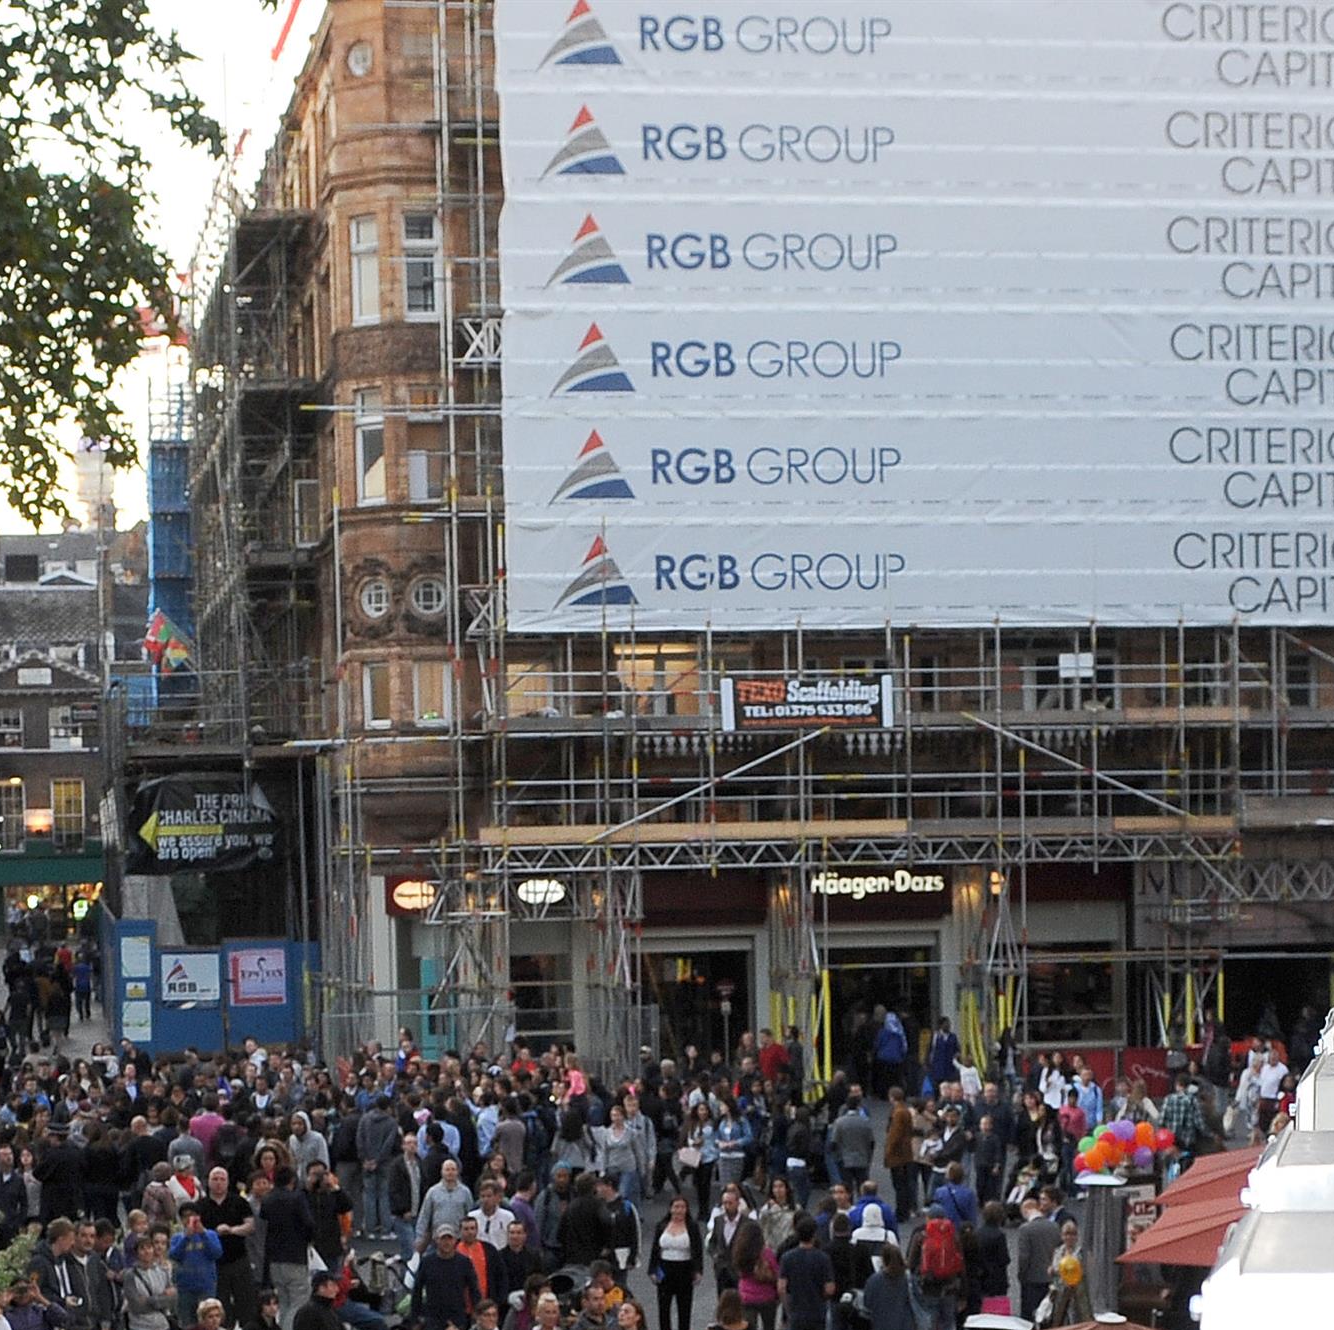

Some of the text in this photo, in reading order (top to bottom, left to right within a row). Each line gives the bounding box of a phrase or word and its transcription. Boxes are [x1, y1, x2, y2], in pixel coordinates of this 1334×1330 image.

[638, 14, 892, 55] RGB GROUP
[641, 122, 895, 164] RGB GROUP
[646, 231, 898, 271] RGB GROUP
[650, 340, 902, 378] RGB GROUP
[650, 447, 902, 485] RGB GROUP
[654, 553, 906, 591] RGB GROUP
[787, 680, 880, 705] Scaffolding
[743, 705, 774, 717] TEL:
[194, 793, 219, 809] THE
[158, 809, 216, 825] CHARLES
[157, 836, 175, 847] we
[179, 835, 222, 847] assure
[157, 848, 179, 860] are
[810, 869, 945, 900] Häagen-Dazs
